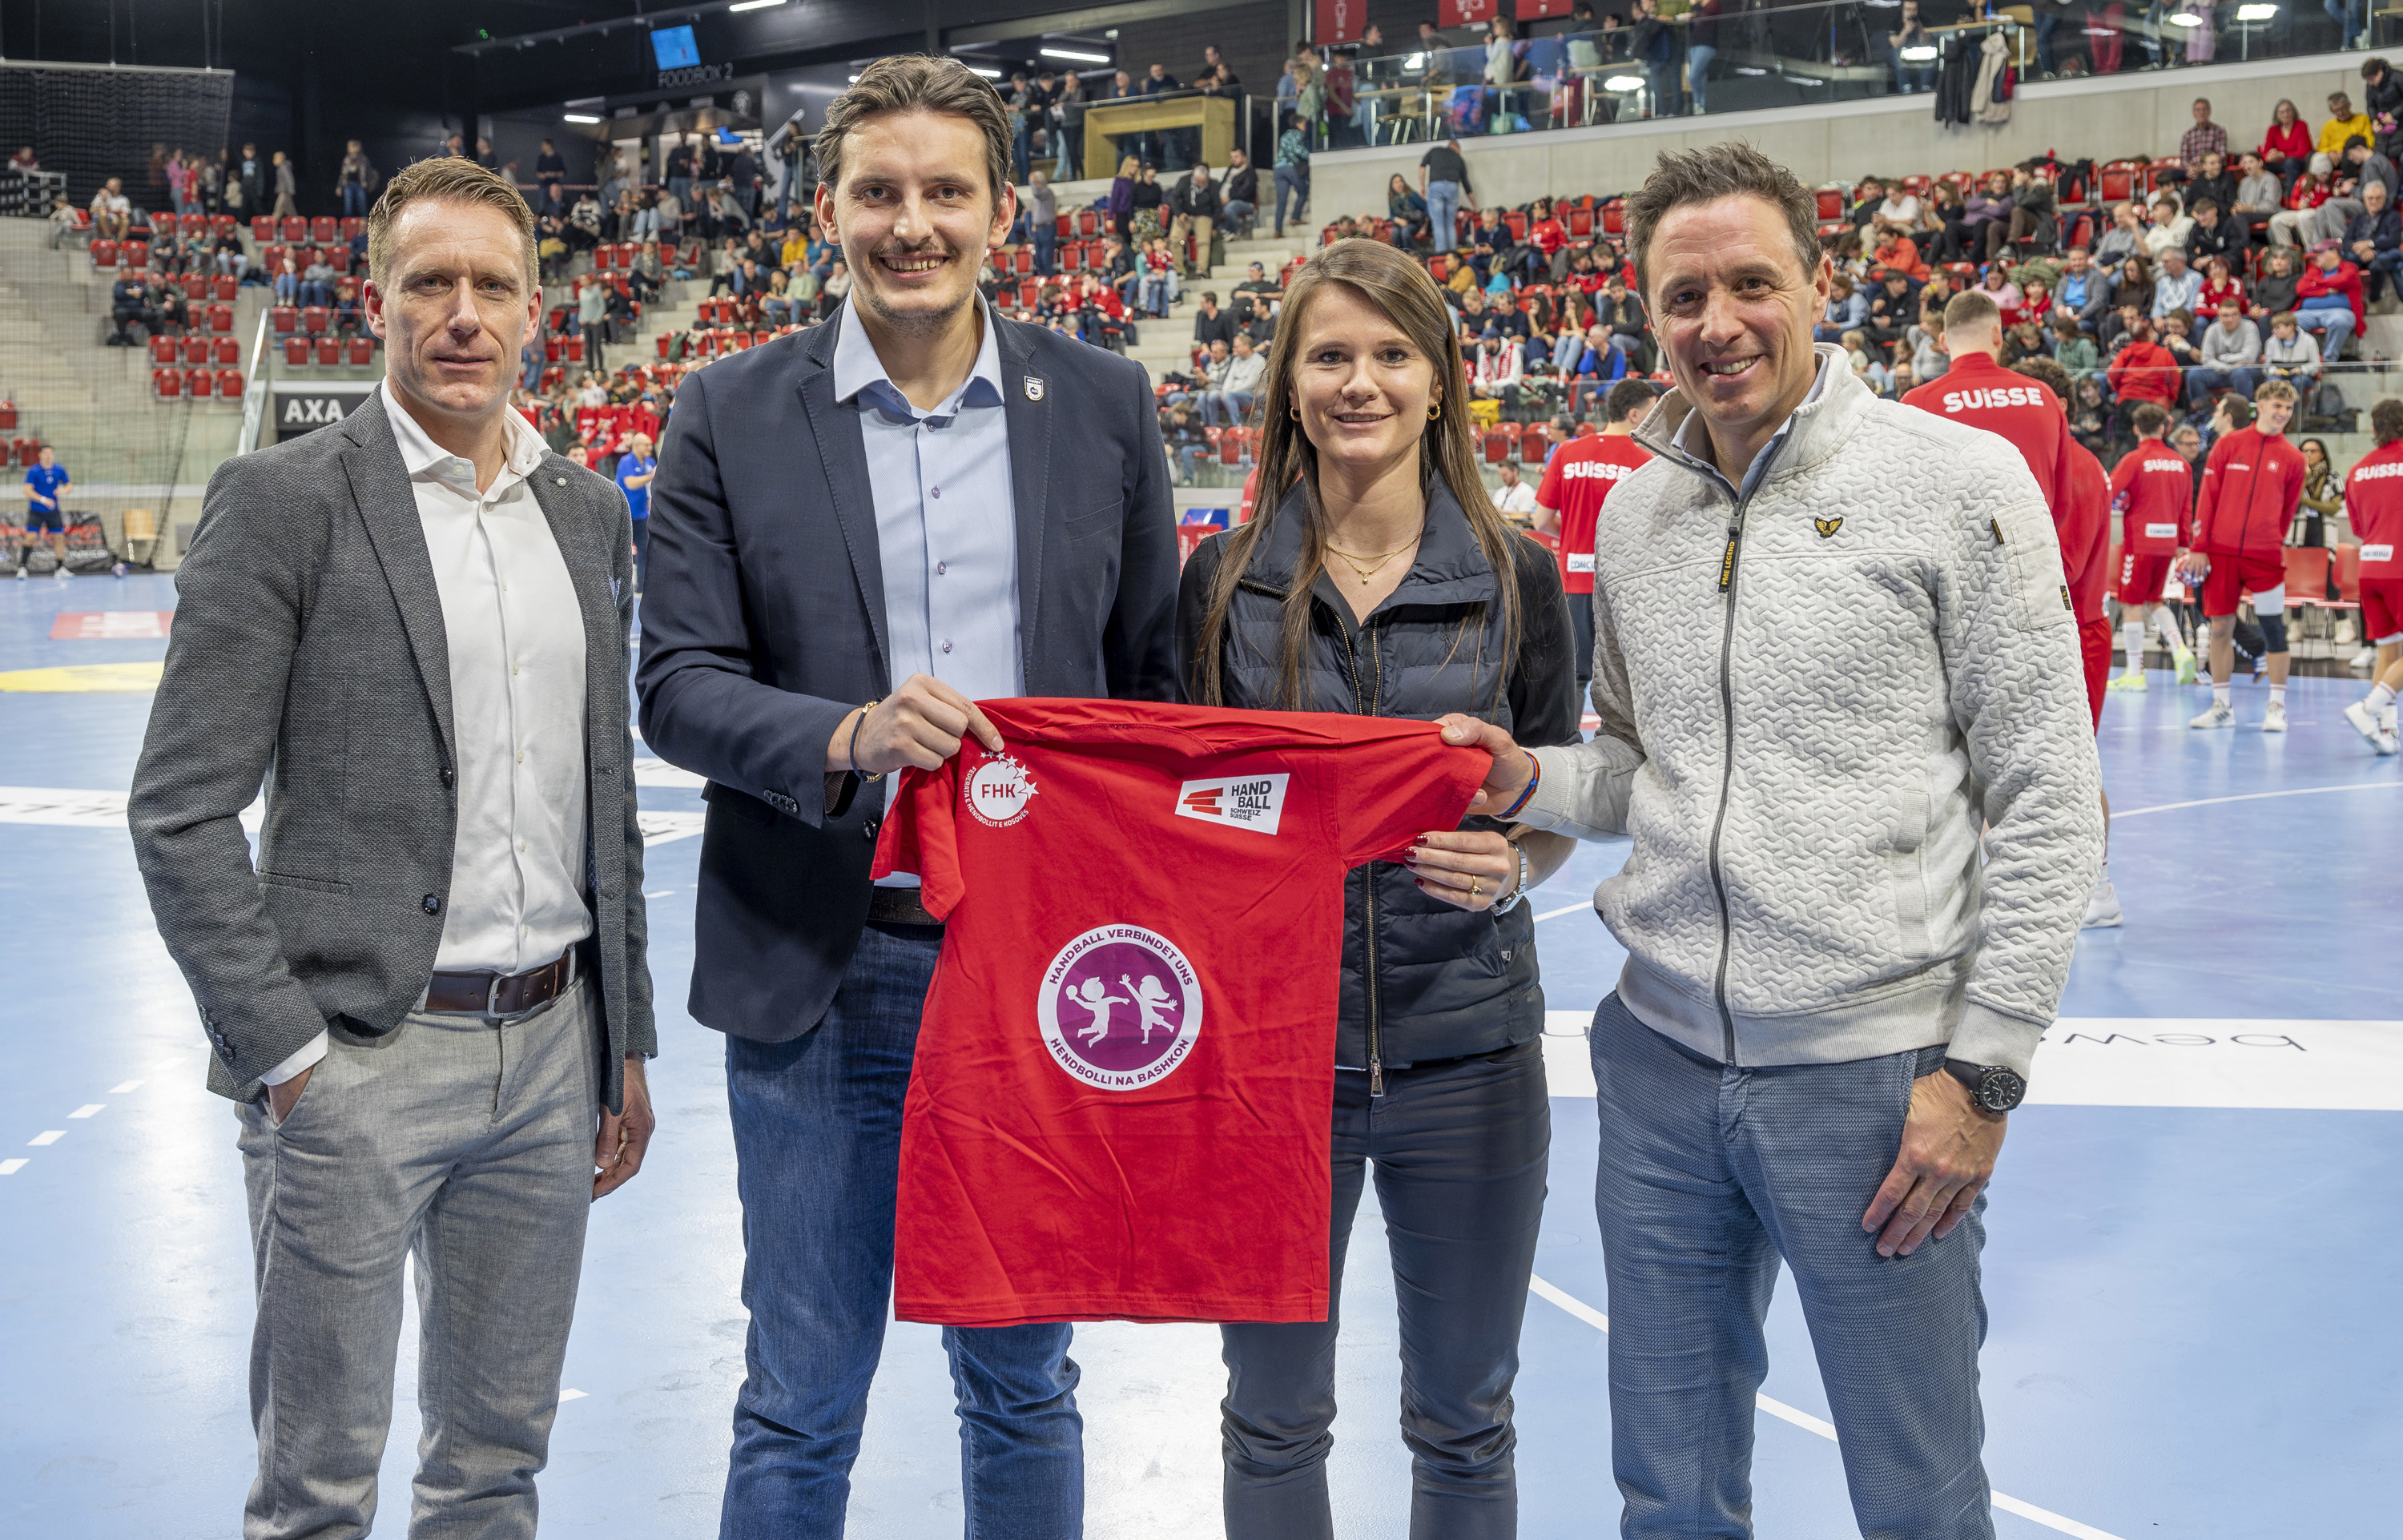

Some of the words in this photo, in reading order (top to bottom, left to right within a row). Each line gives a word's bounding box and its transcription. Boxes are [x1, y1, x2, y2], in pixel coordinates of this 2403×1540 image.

[284, 399, 344, 423] AXA
[1725, 541, 1735, 569] LEGEND
[1721, 569, 1730, 585] PME
[964, 766, 977, 797] FEDERATA
[981, 783, 1016, 798] FHK
[1231, 780, 1272, 797] HAND
[1238, 795, 1271, 810] BALL
[966, 802, 998, 827] HENDBOLLIT
[1004, 809, 1029, 827] KOSOVËS
[1230, 807, 1262, 817] SCHWEIZ
[1230, 813, 1252, 822] SUISSE
[1049, 932, 1105, 985] HANDBALL
[1107, 928, 1177, 960] VERBINDET
[1174, 959, 1193, 986] UNS
[1049, 1037, 1112, 1085] HENDBOLLI
[1115, 1076, 1135, 1086] NA
[1137, 1039, 1189, 1084] BASHKON
